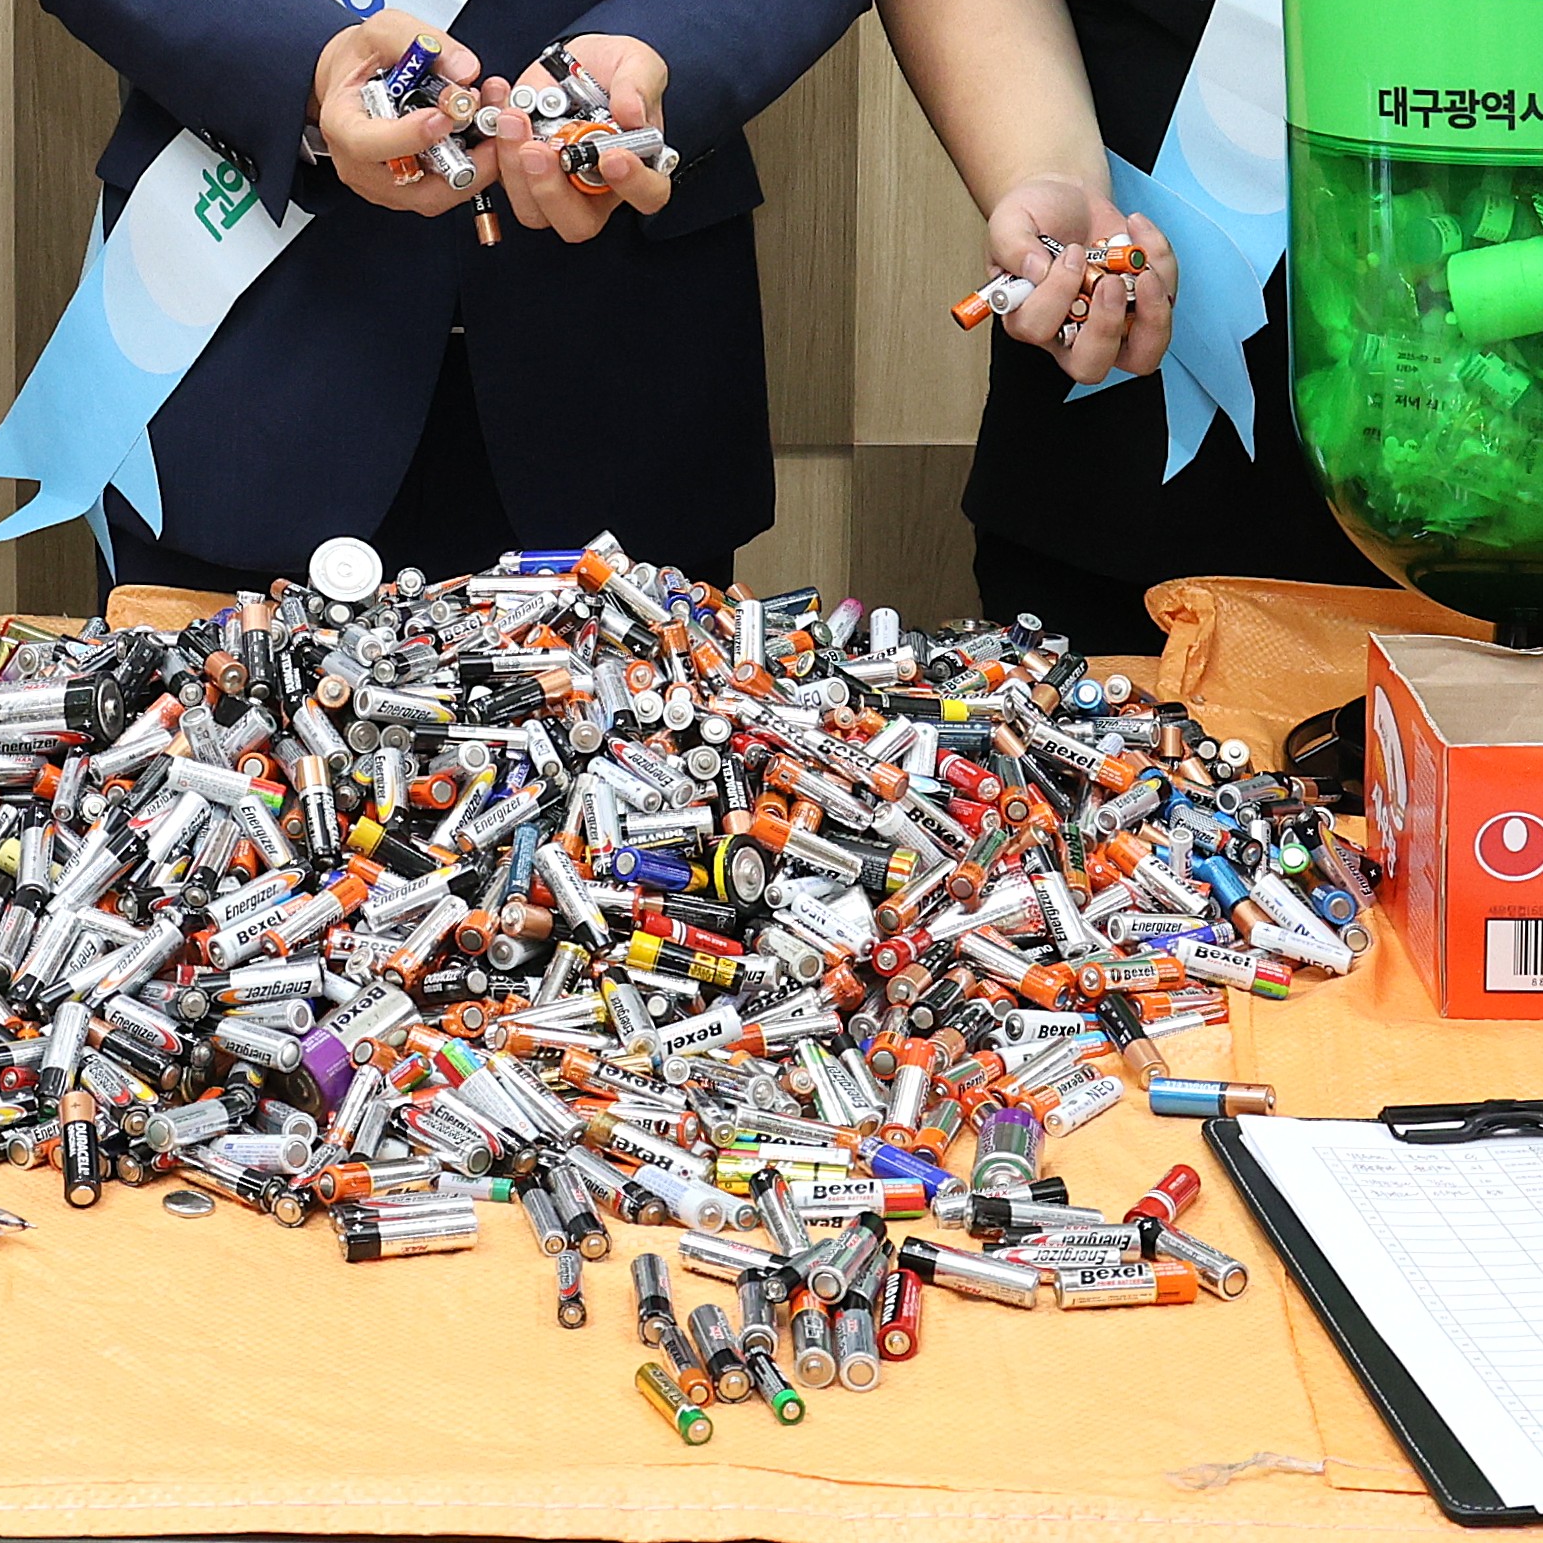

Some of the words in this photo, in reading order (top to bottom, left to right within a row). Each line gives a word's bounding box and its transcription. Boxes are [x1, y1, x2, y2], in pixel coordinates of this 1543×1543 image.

[733, 608, 744, 656] Energizer
[377, 700, 431, 721] Energizer
[1043, 739, 1096, 769] Bexel
[374, 754, 386, 801] Energizer
[474, 797, 523, 835] Energizer
[583, 792, 599, 843] Energizer
[225, 888, 279, 920] Energizer
[1039, 887, 1067, 942] Energizer
[236, 911, 283, 945] Bexel
[1131, 918, 1183, 933] Energizer
[1194, 945, 1252, 969] Bexel
[1123, 965, 1156, 981] Bexel
[245, 979, 312, 998] Energizer
[329, 987, 385, 1033] Bexel
[109, 1008, 159, 1044] Energizer
[667, 1022, 722, 1053] Bexel
[1036, 1023, 1082, 1038] Bexel
[1085, 1079, 1115, 1103] NEO
[75, 1123, 93, 1178] DURACELL
[814, 1181, 877, 1200] Bexel
[1038, 1247, 1117, 1265] Energizer
[1081, 1264, 1147, 1286] Bexel
